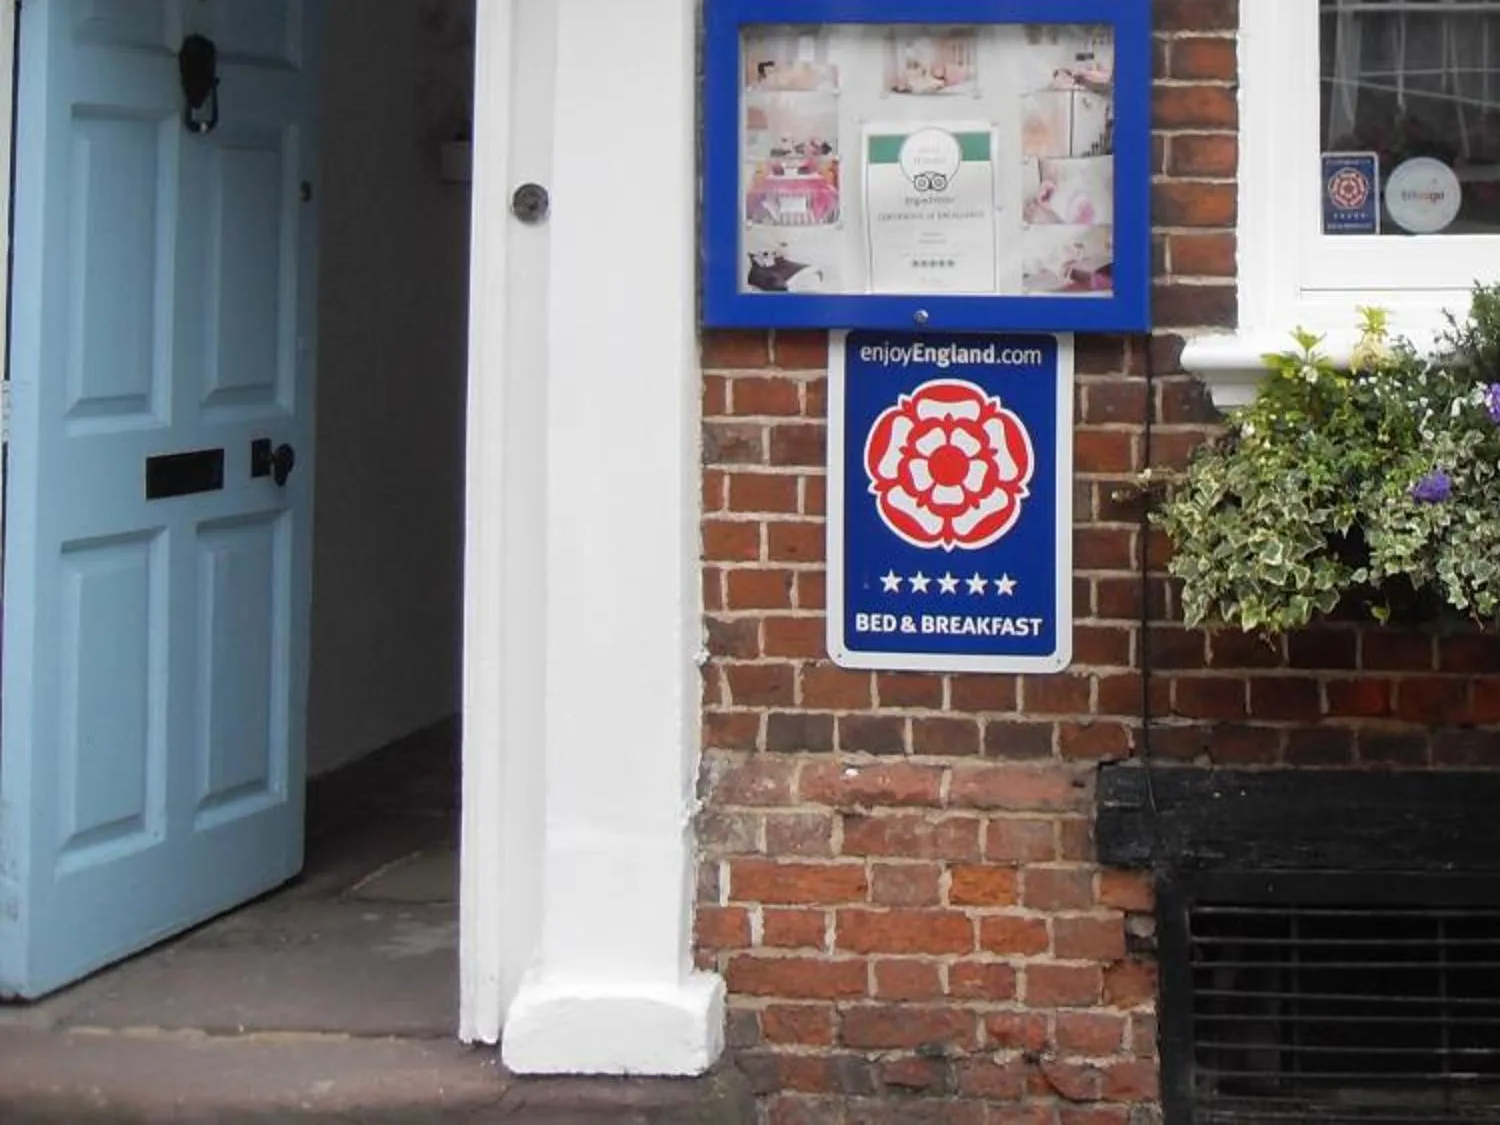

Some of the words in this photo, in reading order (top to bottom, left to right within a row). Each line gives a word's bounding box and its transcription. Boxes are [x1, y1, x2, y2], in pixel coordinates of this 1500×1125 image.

[860, 342, 1042, 367] enjoyEngland.com
[855, 613, 896, 632] BED
[900, 615, 917, 633] &
[921, 615, 1043, 636] BREAKFAST
